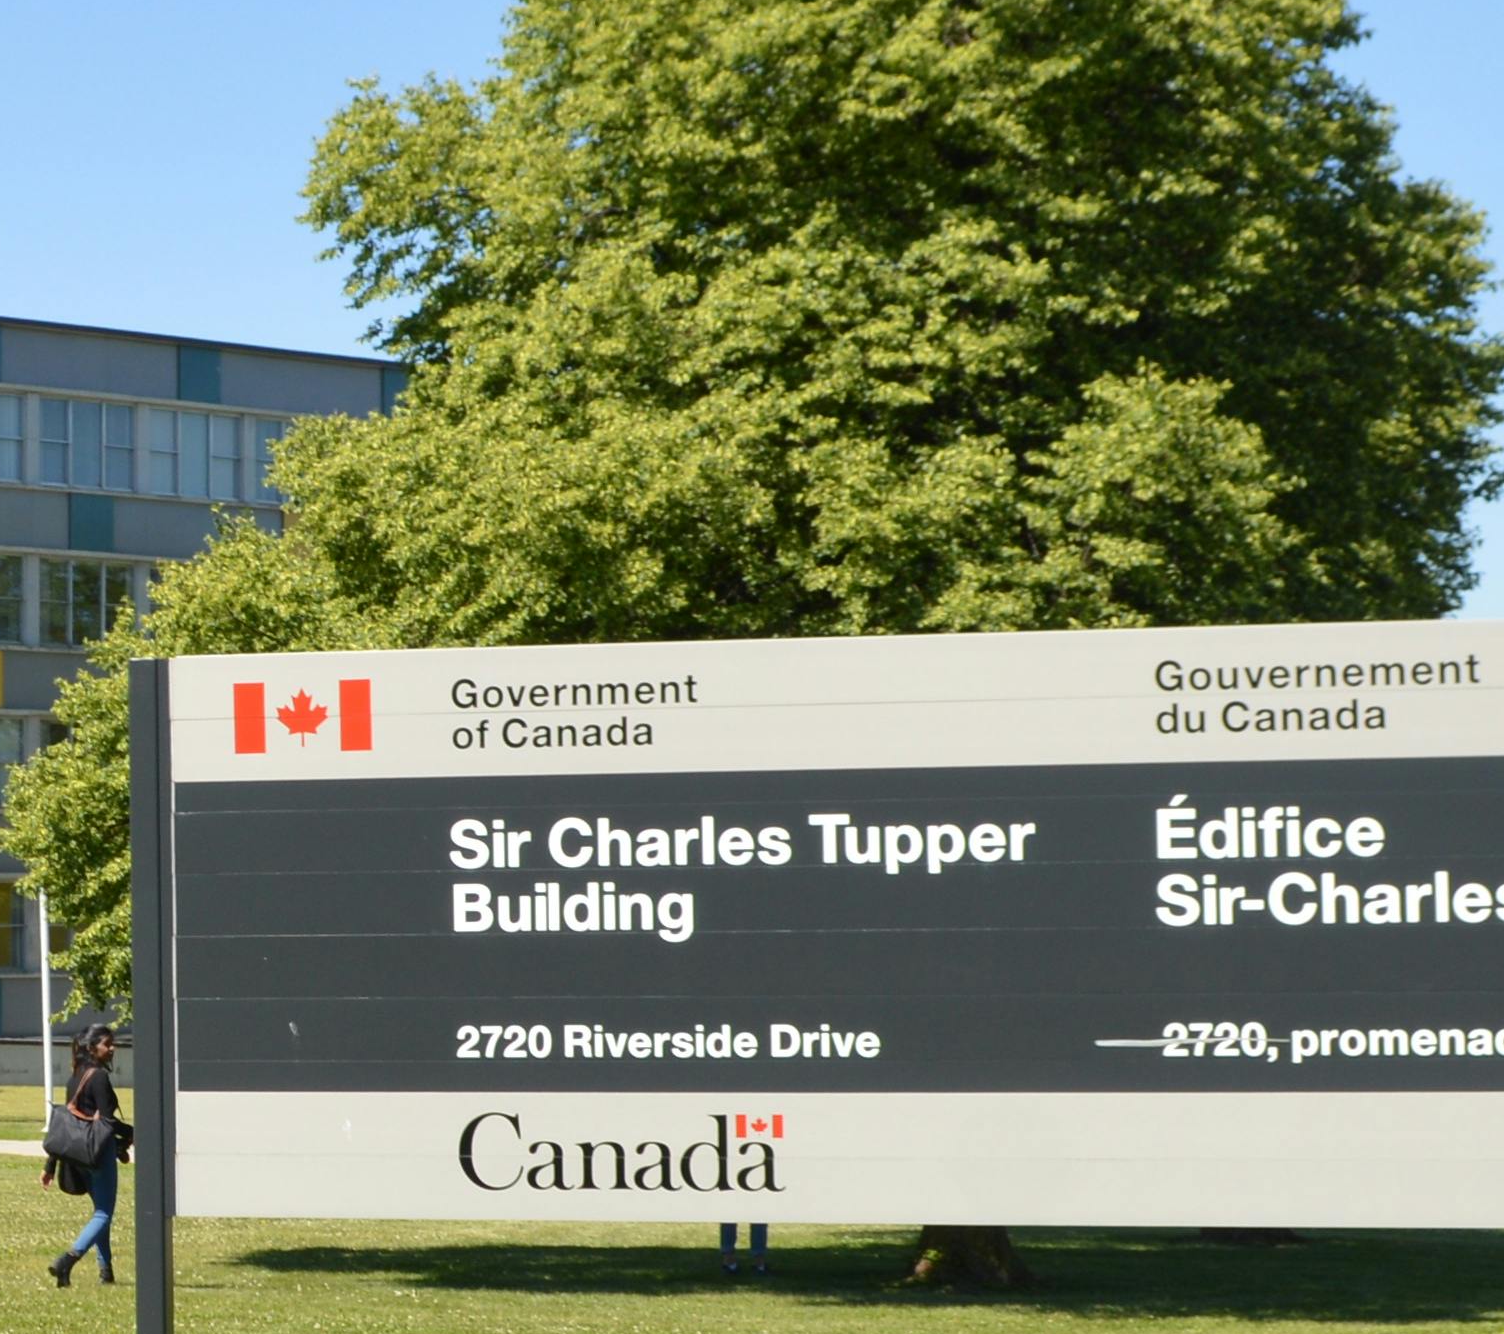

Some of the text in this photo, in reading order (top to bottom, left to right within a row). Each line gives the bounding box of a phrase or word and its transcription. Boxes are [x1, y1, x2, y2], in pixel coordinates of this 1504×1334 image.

[451, 675, 697, 709] Government
[1155, 656, 1480, 692] Gouvernement
[452, 716, 653, 750] of Canada
[1156, 699, 1385, 734] du Canada
[449, 813, 1037, 875] Sir Charles Tupper
[1155, 793, 1386, 860] Édifice
[452, 881, 695, 943] Building
[456, 1023, 881, 1059] 2720 Riverside Drive
[1161, 1021, 1280, 1063] 2720,
[458, 1112, 784, 1192] Canada
